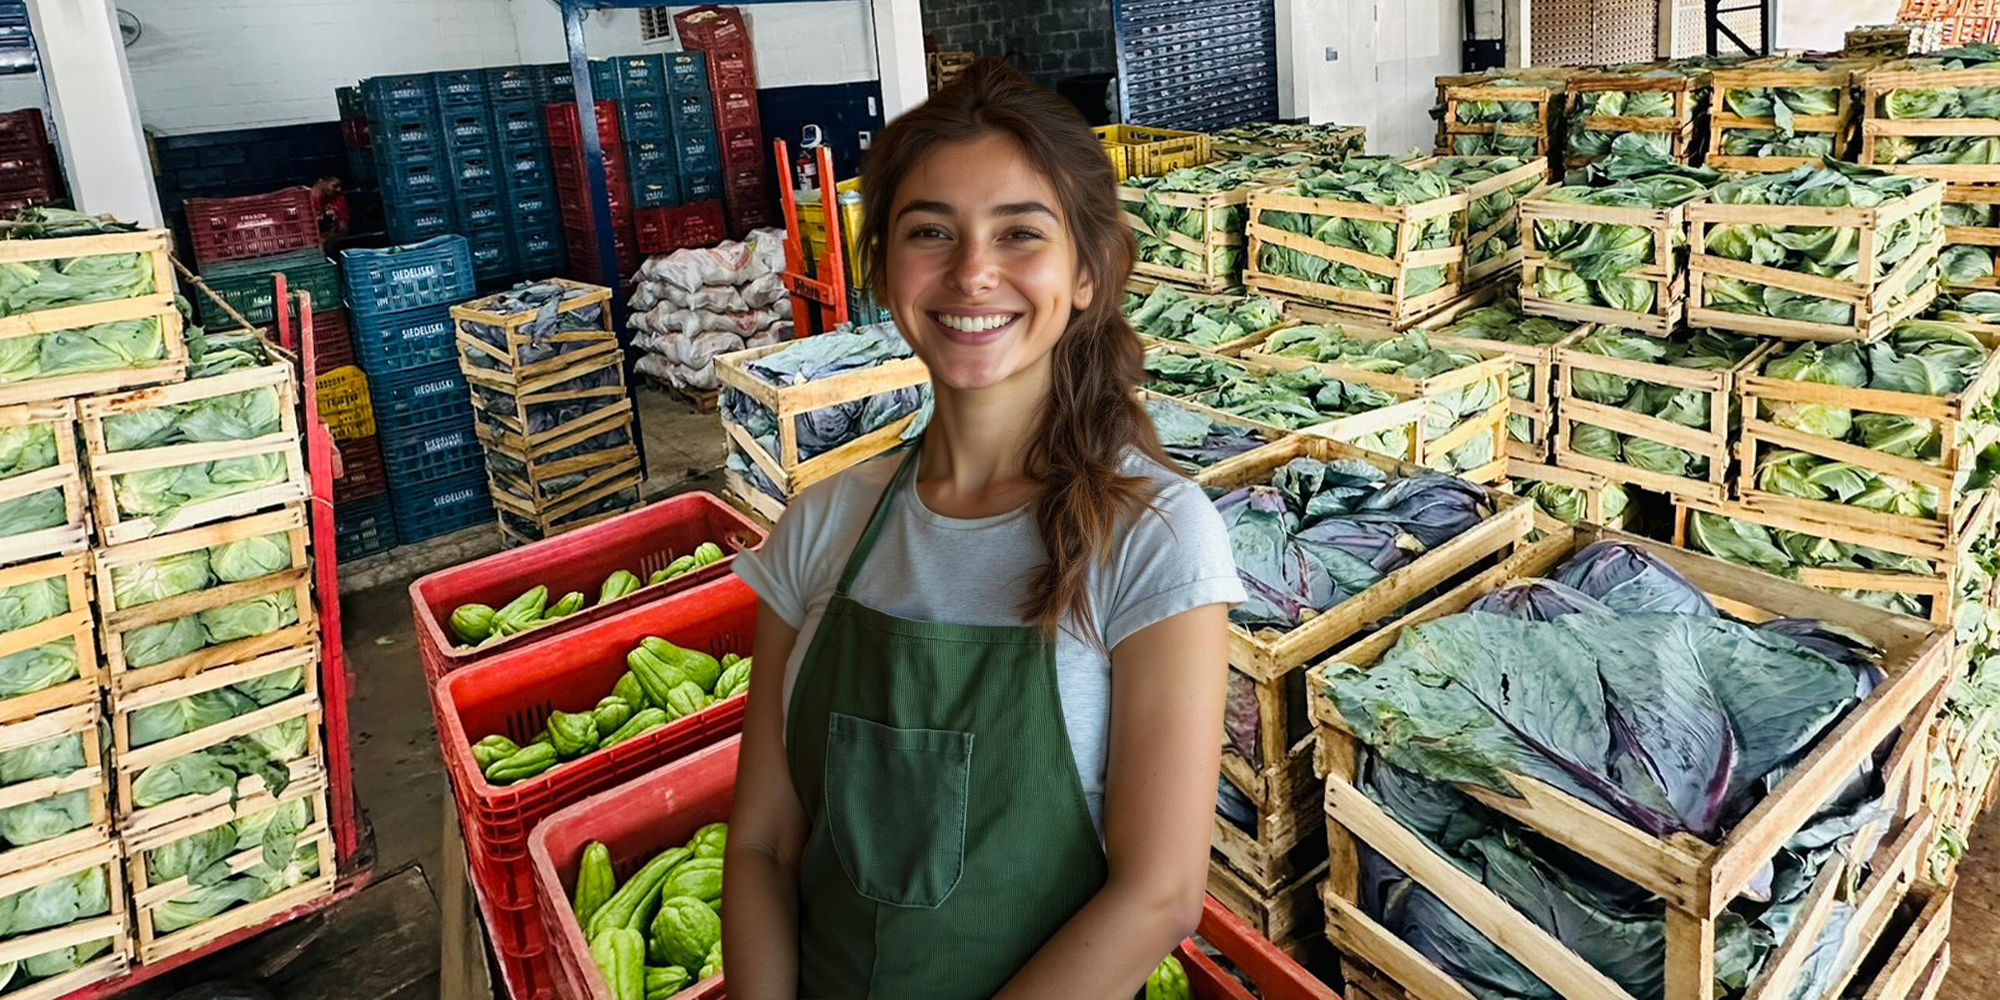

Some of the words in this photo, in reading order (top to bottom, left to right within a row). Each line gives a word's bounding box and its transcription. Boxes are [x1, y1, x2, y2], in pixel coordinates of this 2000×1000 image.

[391, 264, 435, 281] SIEDELISKI
[401, 322, 444, 340] SIEDELISKI
[413, 380, 454, 396] SIEDELISKI
[433, 488, 474, 506] SIEDELISKI
